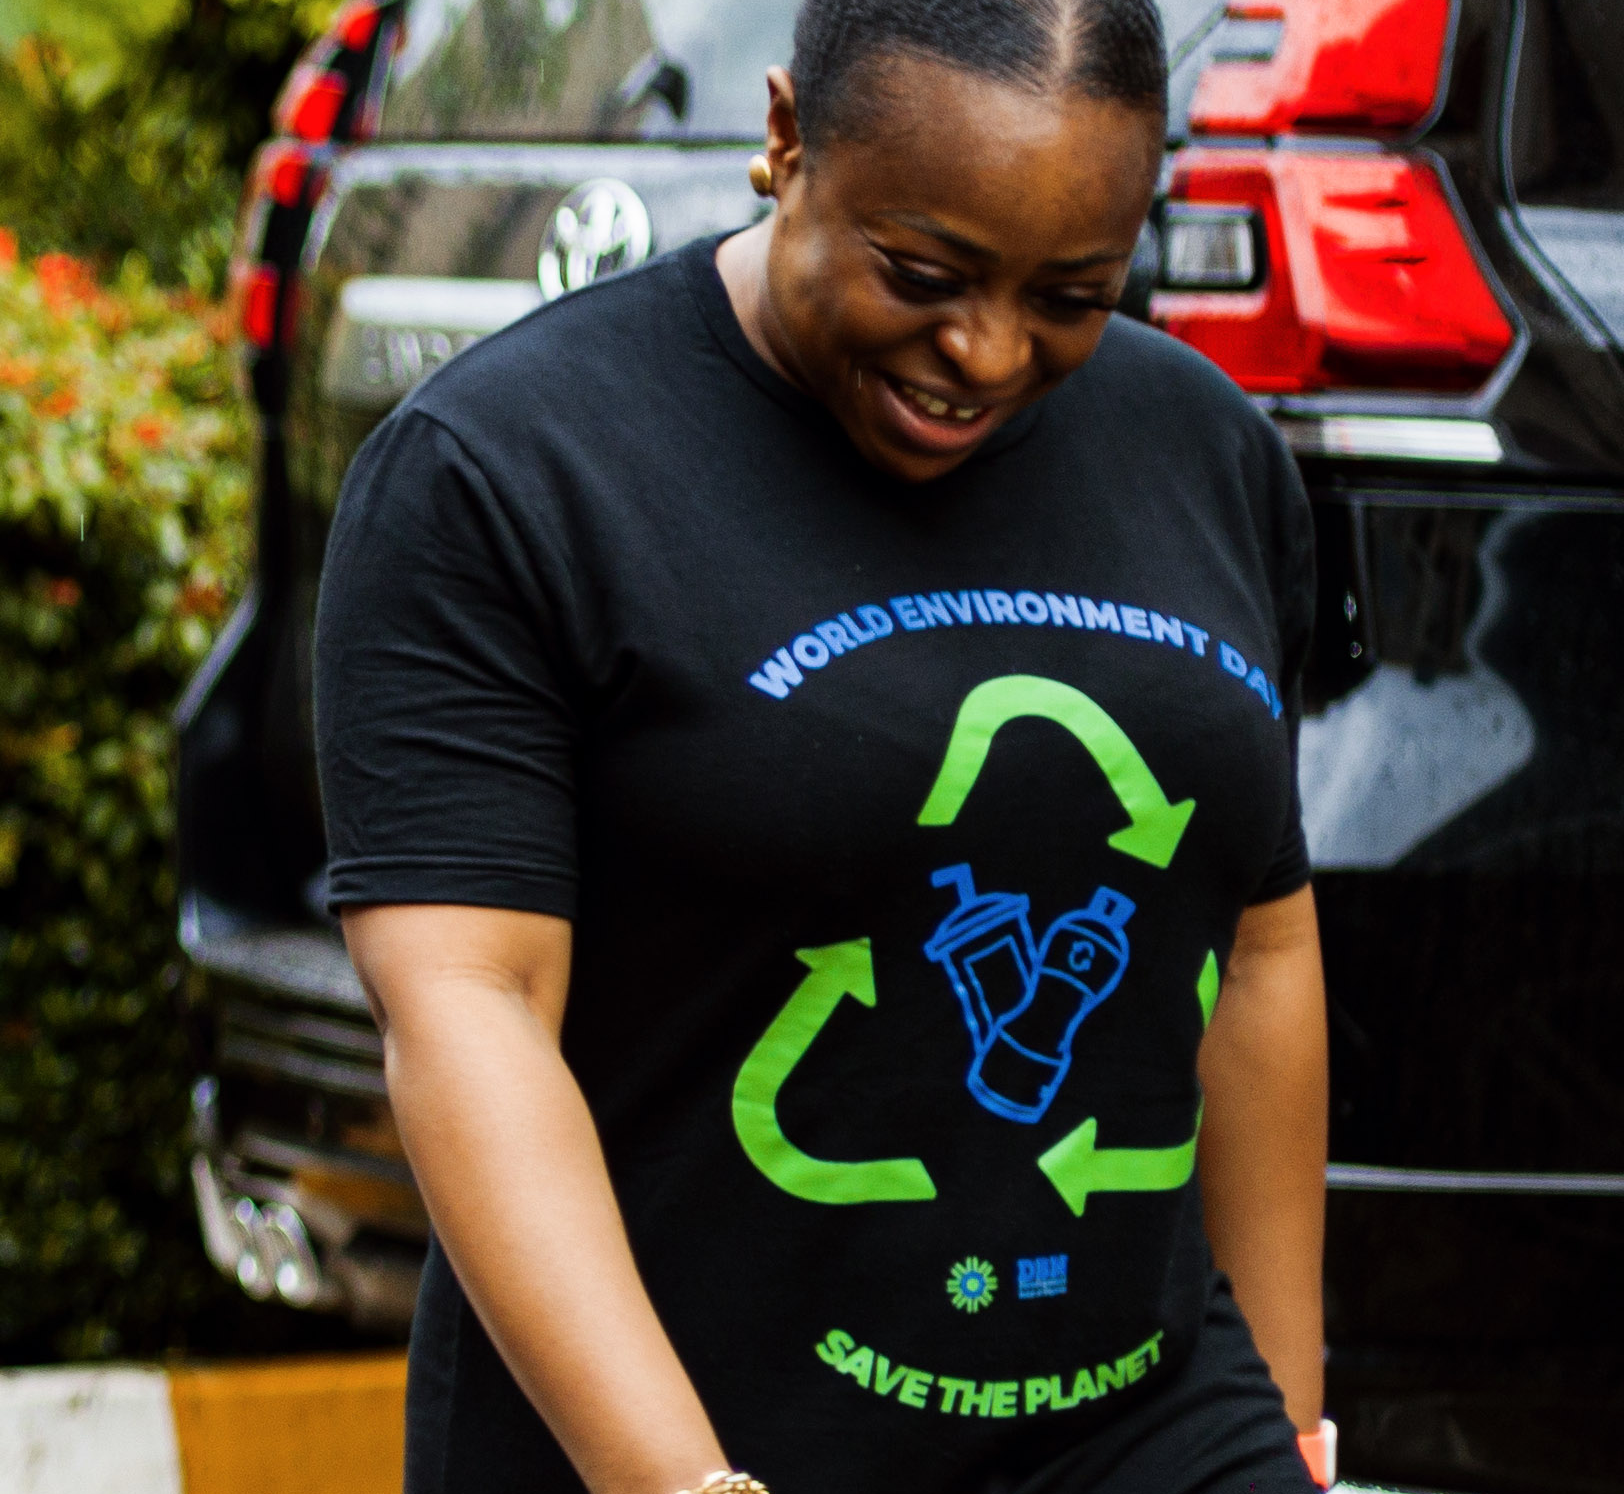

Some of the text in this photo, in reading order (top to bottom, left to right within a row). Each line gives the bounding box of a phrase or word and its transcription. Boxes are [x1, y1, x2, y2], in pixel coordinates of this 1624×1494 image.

[746, 602, 895, 701] WORLD
[888, 587, 1211, 658] ENVIRONMENT
[814, 1327, 1165, 1418] SAVE THE PLANET
